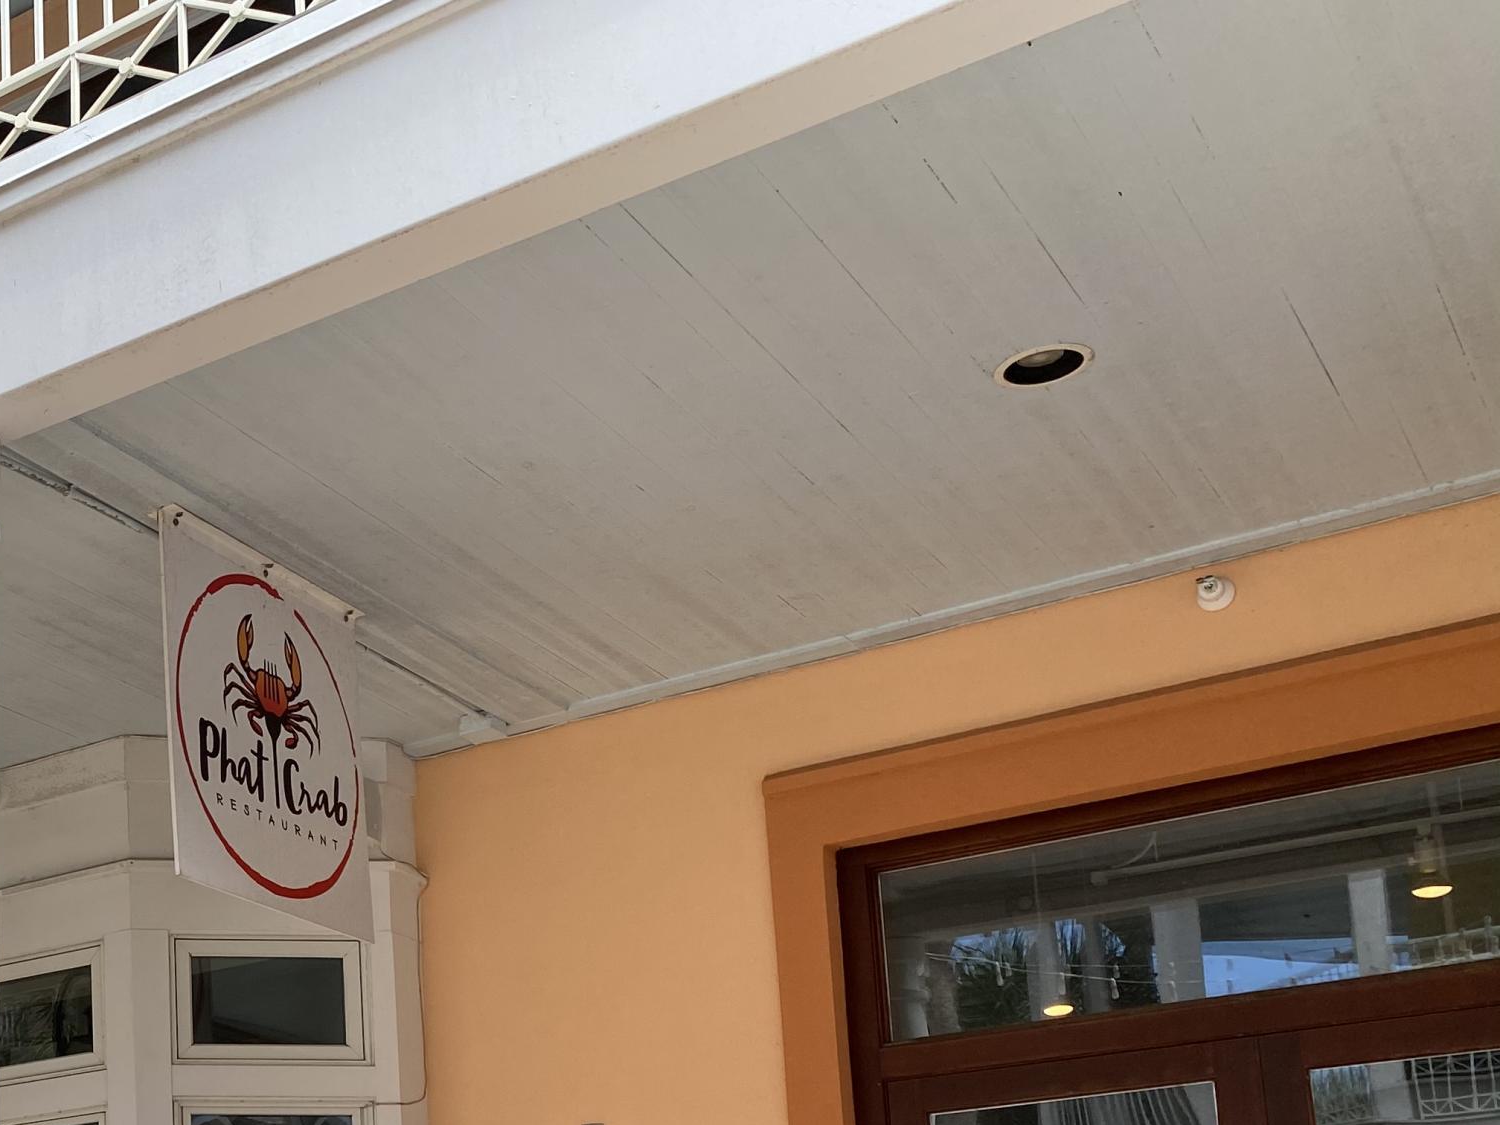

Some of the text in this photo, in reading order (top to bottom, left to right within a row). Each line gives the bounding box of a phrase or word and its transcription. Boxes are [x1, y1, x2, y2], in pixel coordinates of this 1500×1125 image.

[199, 717, 348, 827] Phat Crab
[216, 792, 338, 851] RESTAURANT
